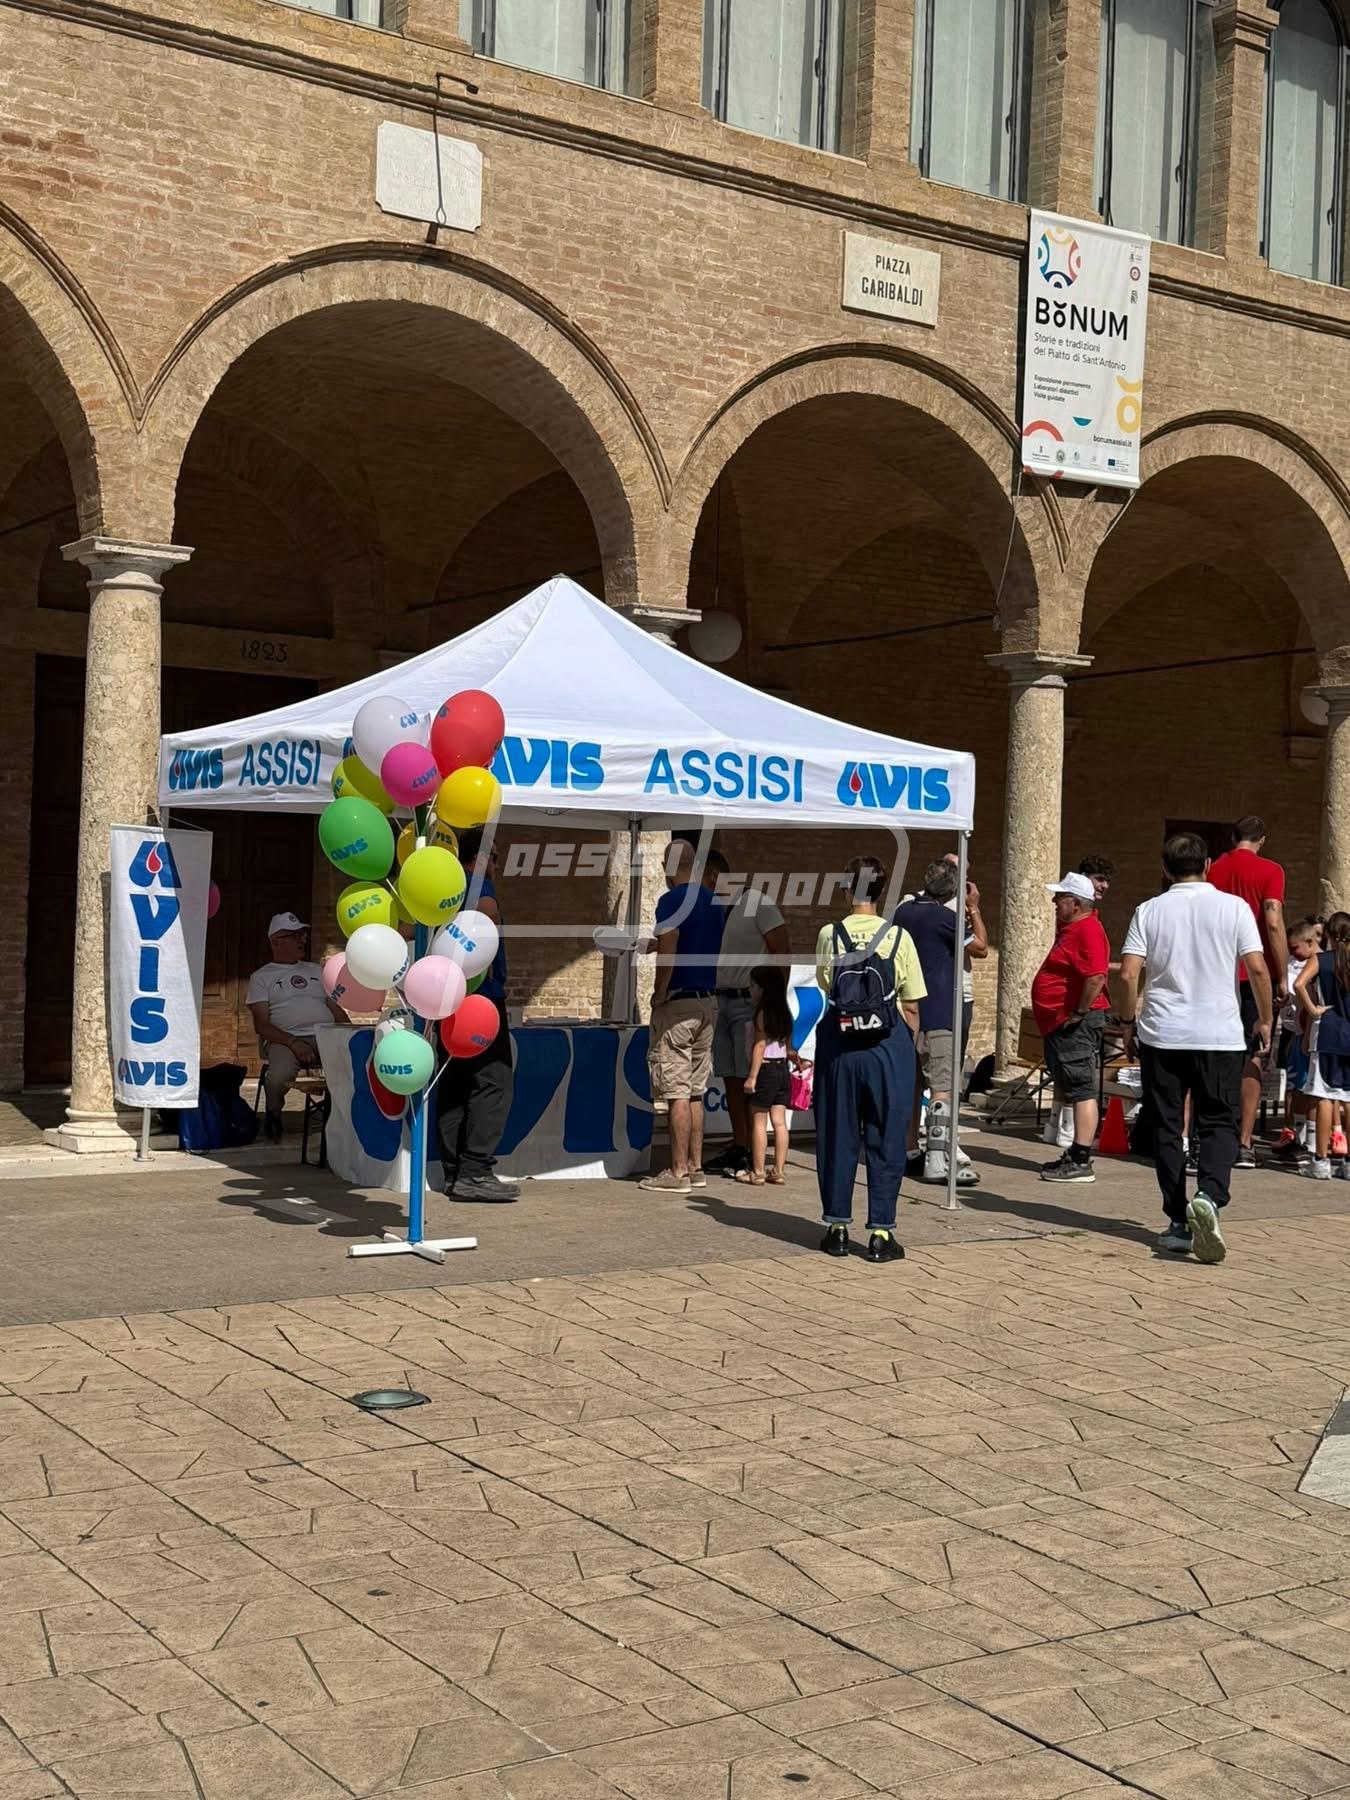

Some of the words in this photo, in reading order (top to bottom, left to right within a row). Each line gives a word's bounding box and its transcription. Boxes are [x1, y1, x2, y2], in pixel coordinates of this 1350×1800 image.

[876, 254, 911, 276] PIAZZA
[862, 276, 923, 307] GARIBALDI
[1034, 332, 1056, 345] Storie
[1058, 338, 1063, 346] e
[1065, 338, 1101, 352] tradizioni
[1048, 348, 1070, 361] Piatto
[1072, 353, 1080, 362] di
[1082, 354, 1126, 371] Sant'Antonio
[1093, 434, 1132, 447] bonumassisi.it
[241, 639, 288, 663] 1823
[168, 748, 224, 790] AVIS
[238, 739, 321, 786] ASSISI
[643, 748, 804, 803] ASSISI
[836, 761, 951, 812] AVIS
[330, 838, 368, 861] AVIS
[347, 894, 382, 919] AVIS
[129, 840, 182, 1044] AVIS
[445, 922, 477, 953] AVIS
[840, 1013, 883, 1032] FILA
[118, 1057, 188, 1087] AVIS
[379, 1063, 414, 1076] AVIS
